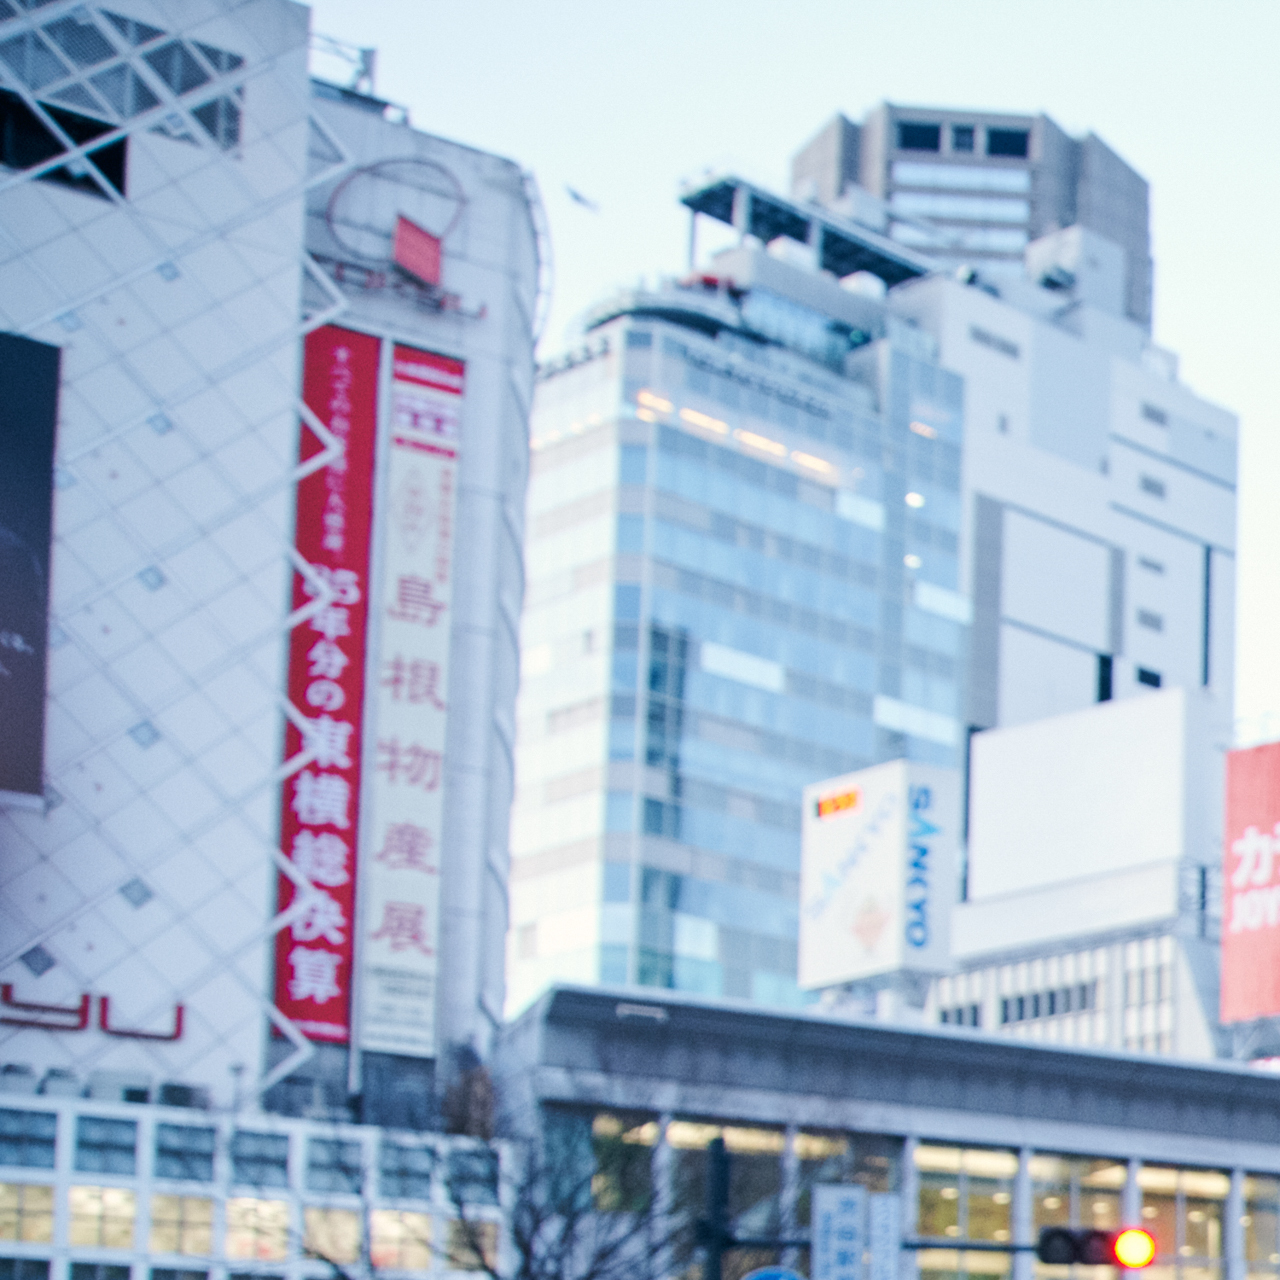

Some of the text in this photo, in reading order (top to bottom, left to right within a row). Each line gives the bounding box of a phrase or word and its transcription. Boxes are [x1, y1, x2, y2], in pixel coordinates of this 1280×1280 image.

[371, 572, 447, 958] 島根物産展
[904, 783, 940, 948] SANKYO
